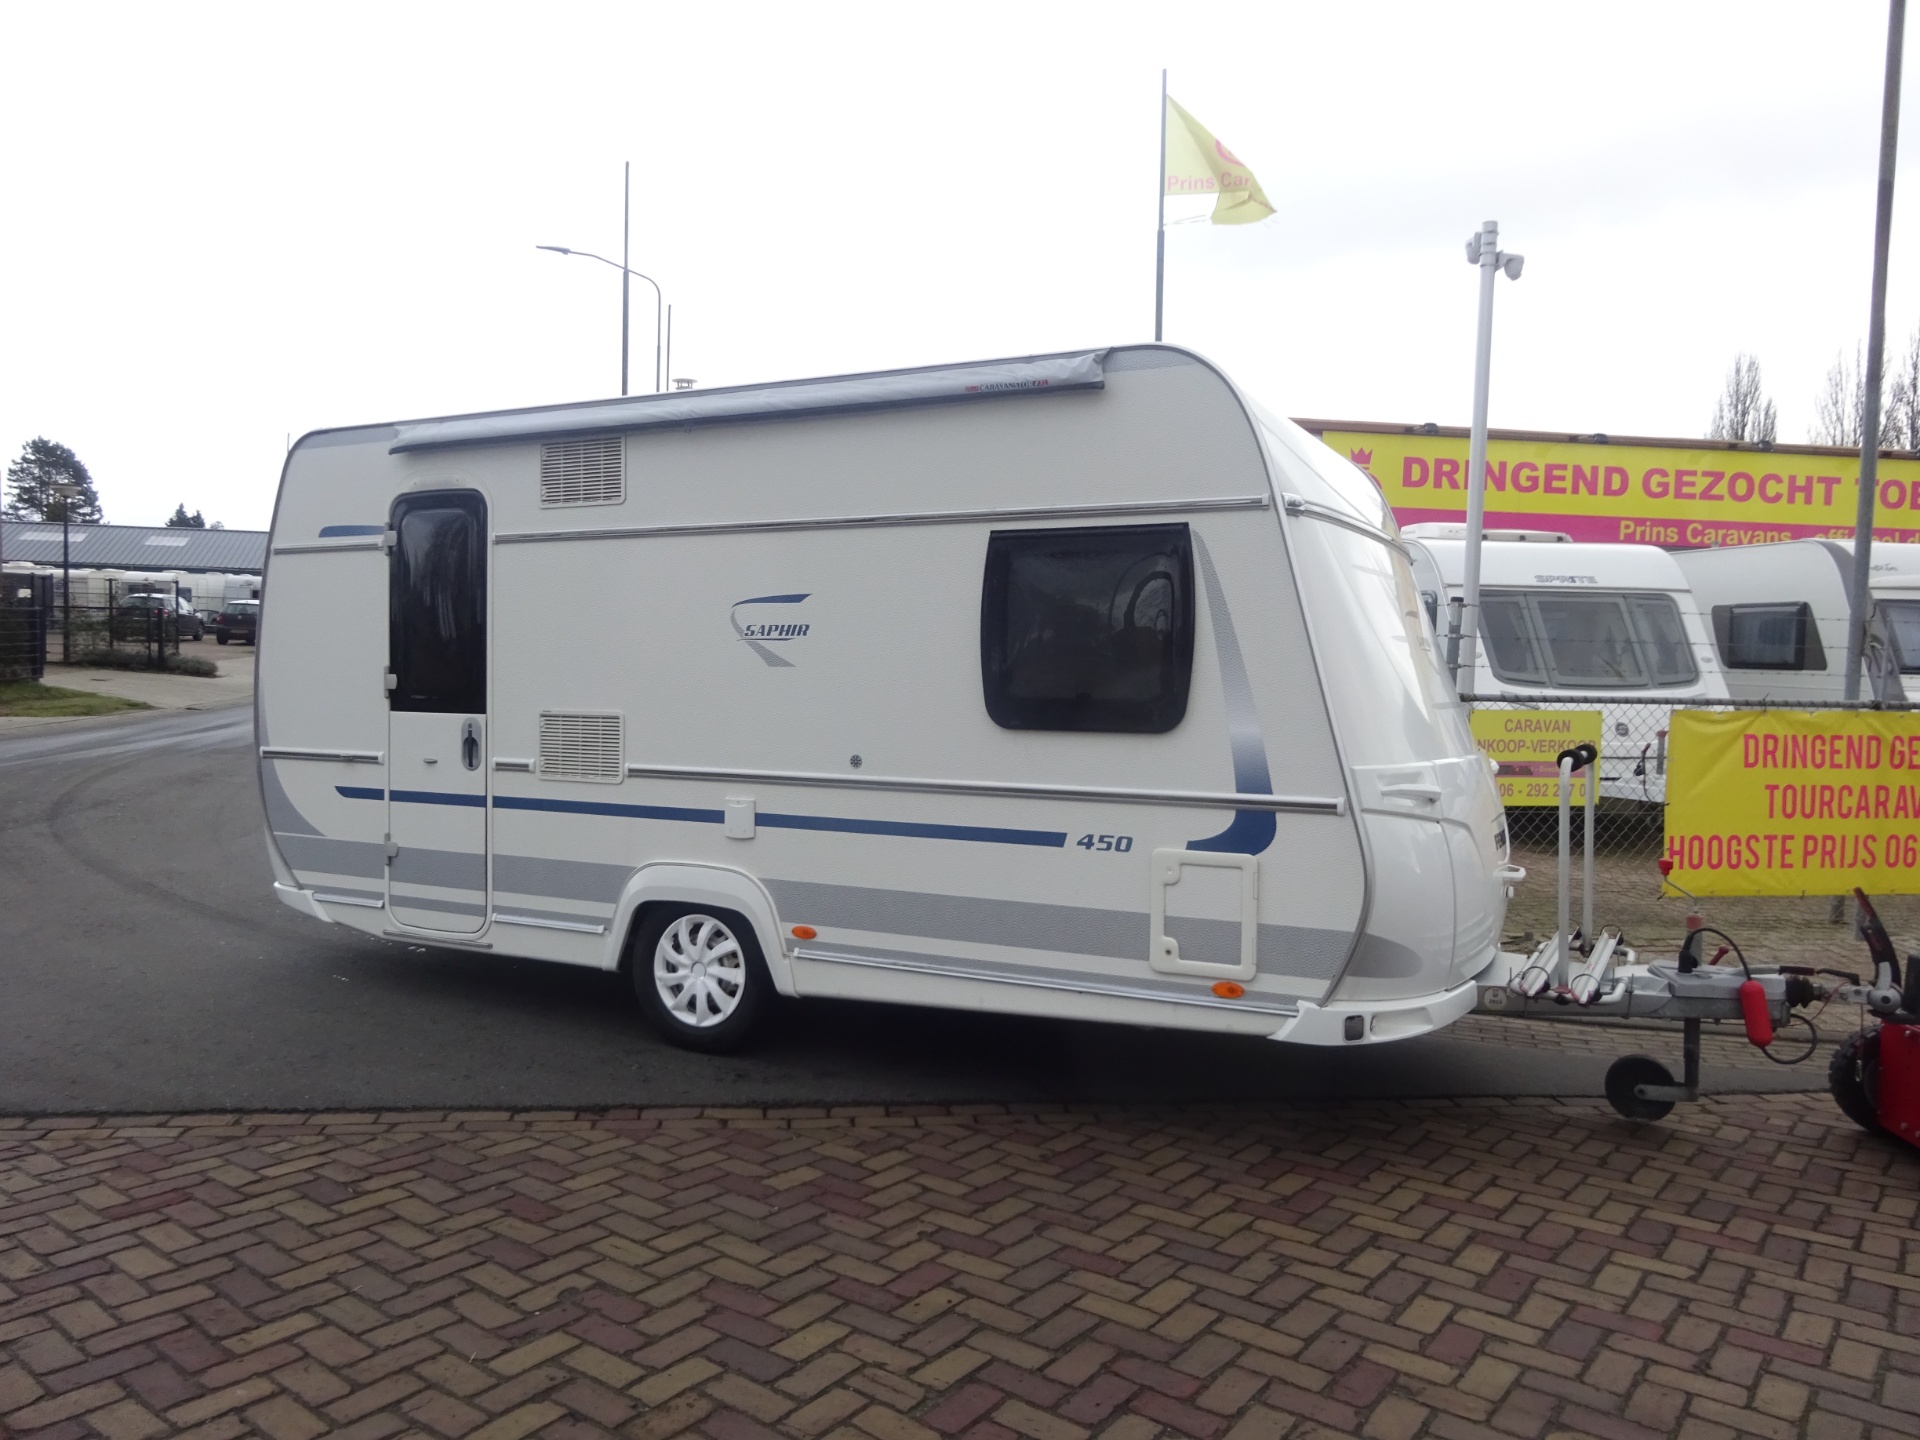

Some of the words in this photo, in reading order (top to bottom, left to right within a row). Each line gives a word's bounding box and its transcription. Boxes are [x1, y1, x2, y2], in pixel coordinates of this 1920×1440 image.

[1167, 175, 1215, 191] Prins
[1402, 456, 1629, 497] DRINGEND
[1642, 468, 1841, 506] GEZOCHT
[1619, 520, 1679, 543] Prins
[1686, 523, 1792, 545] Caravans
[744, 624, 810, 637] SAPHIR
[1504, 719, 1571, 733] CARAVAN
[1743, 734, 1882, 769] DRINGEND
[1889, 735, 1920, 770] GE
[1526, 783, 1549, 797] 292
[1764, 784, 1920, 819] TOURCARAV
[1076, 833, 1133, 852] 450
[1669, 834, 1795, 870] HOOGSTE
[1802, 834, 1877, 869] PRIJS
